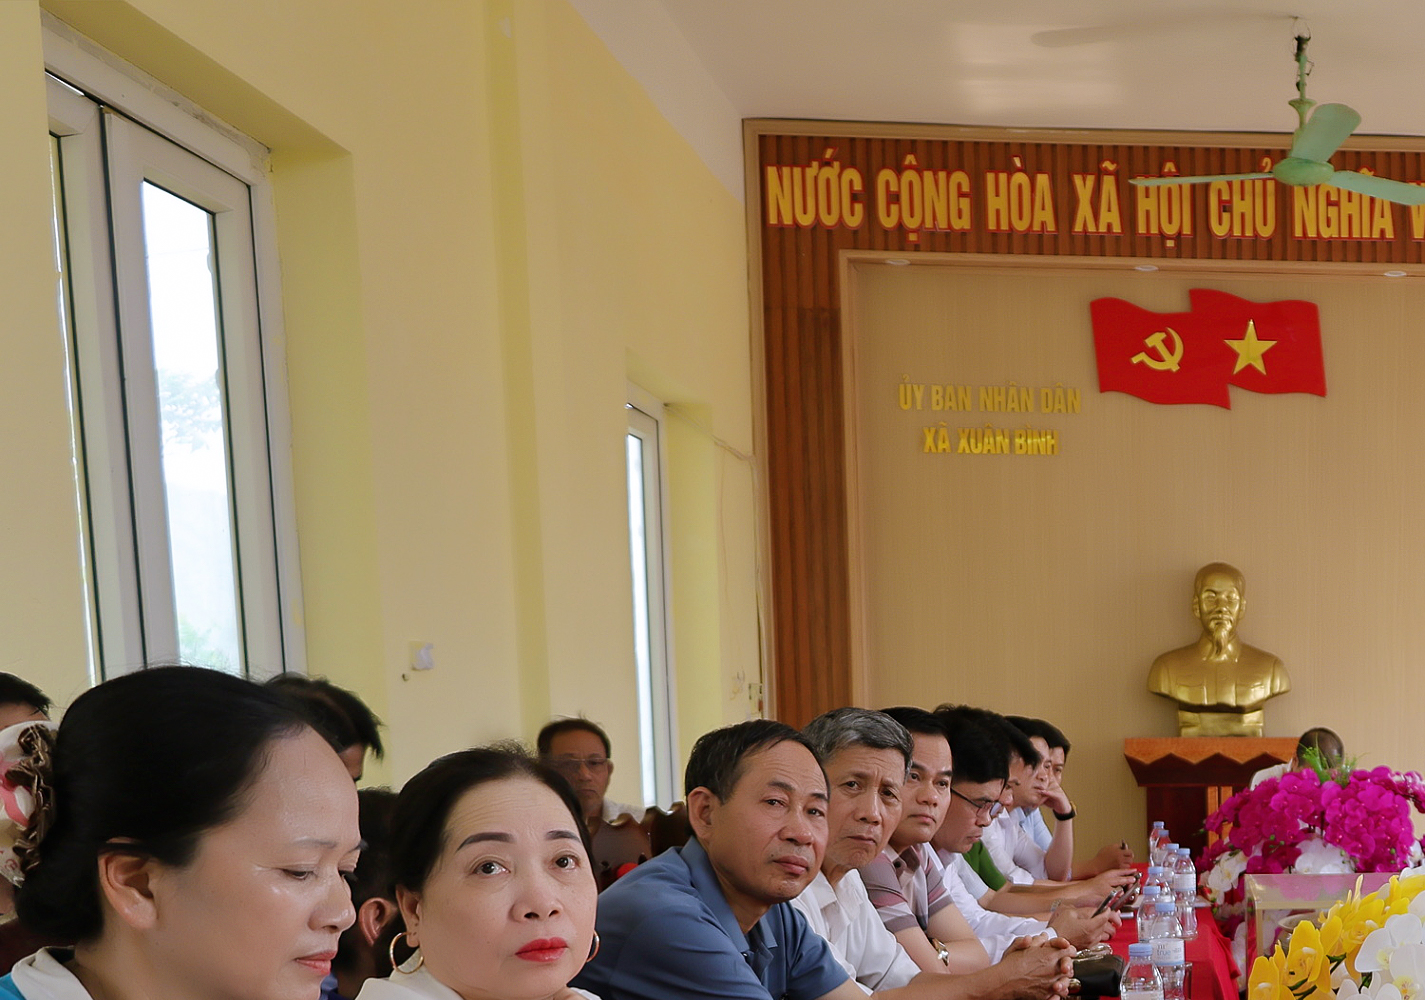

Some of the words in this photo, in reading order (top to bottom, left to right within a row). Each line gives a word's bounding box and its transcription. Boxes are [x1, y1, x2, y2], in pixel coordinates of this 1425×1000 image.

[768, 148, 863, 227] NƯỚC
[877, 154, 971, 241] CỘNG
[985, 156, 1056, 233] HÒA
[1073, 161, 1123, 233] XÃ
[1137, 162, 1192, 247] HỘI
[1209, 157, 1276, 238] CHỦ
[1294, 167, 1394, 240] NGHĨA
[899, 374, 925, 410] ỦY
[931, 384, 972, 411] BAN
[979, 381, 1034, 412] NHÂN
[1041, 382, 1081, 413] DÂN
[923, 422, 950, 453] XÃ
[957, 423, 1010, 454] XUÂN
[1015, 424, 1059, 455] BÌNH
